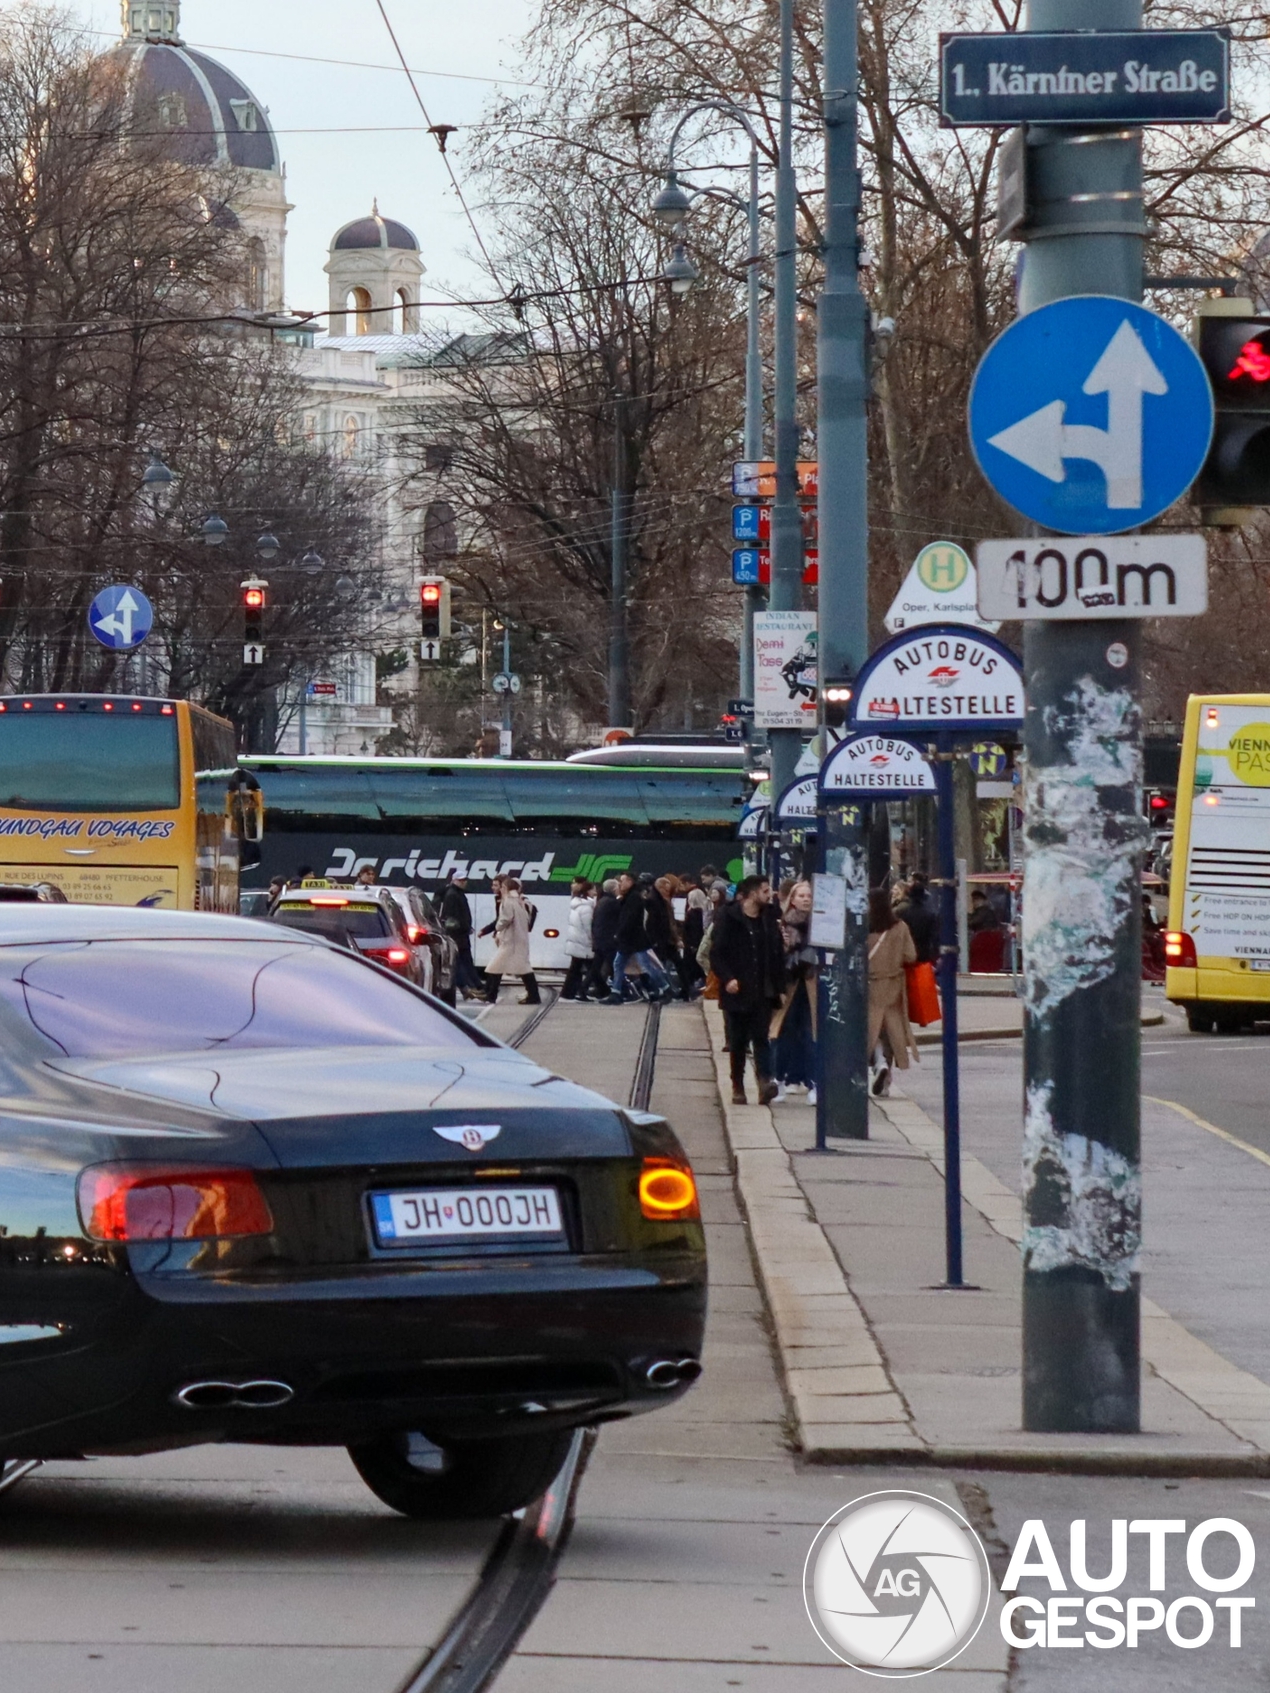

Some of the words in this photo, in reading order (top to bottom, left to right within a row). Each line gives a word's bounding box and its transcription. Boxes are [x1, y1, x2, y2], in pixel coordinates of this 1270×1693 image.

[951, 63, 980, 98] 1.,
[987, 62, 1118, 96] Kärntner
[1123, 60, 1218, 95] Straße
[931, 553, 955, 583] H
[1005, 548, 1177, 608] 100m
[902, 603, 930, 613] Oper,
[933, 603, 978, 613] Karlsplat
[765, 612, 800, 620] INDIAN
[756, 636, 785, 652] Demi
[756, 654, 783, 667] Tass
[892, 640, 998, 676] AUTOBUS
[848, 738, 914, 762] AUTOBUS
[977, 754, 998, 775] N
[834, 773, 925, 787] HALTESTELLE
[840, 812, 855, 826] N
[86, 819, 176, 842] VOYAGES
[379, 849, 555, 882] richard
[4, 872, 20, 880] RUE
[21, 872, 36, 880] DES
[37, 872, 64, 880] LUPINS
[105, 874, 164, 882] PFETTERHOUSE
[1204, 896, 1222, 904] Free
[1223, 898, 1258, 906] entrance
[1241, 913, 1252, 921] ON
[1204, 927, 1222, 935] Save
[1242, 928, 1258, 936] and
[1234, 946, 1270, 955] VIENNA
[402, 1197, 442, 1230] JH
